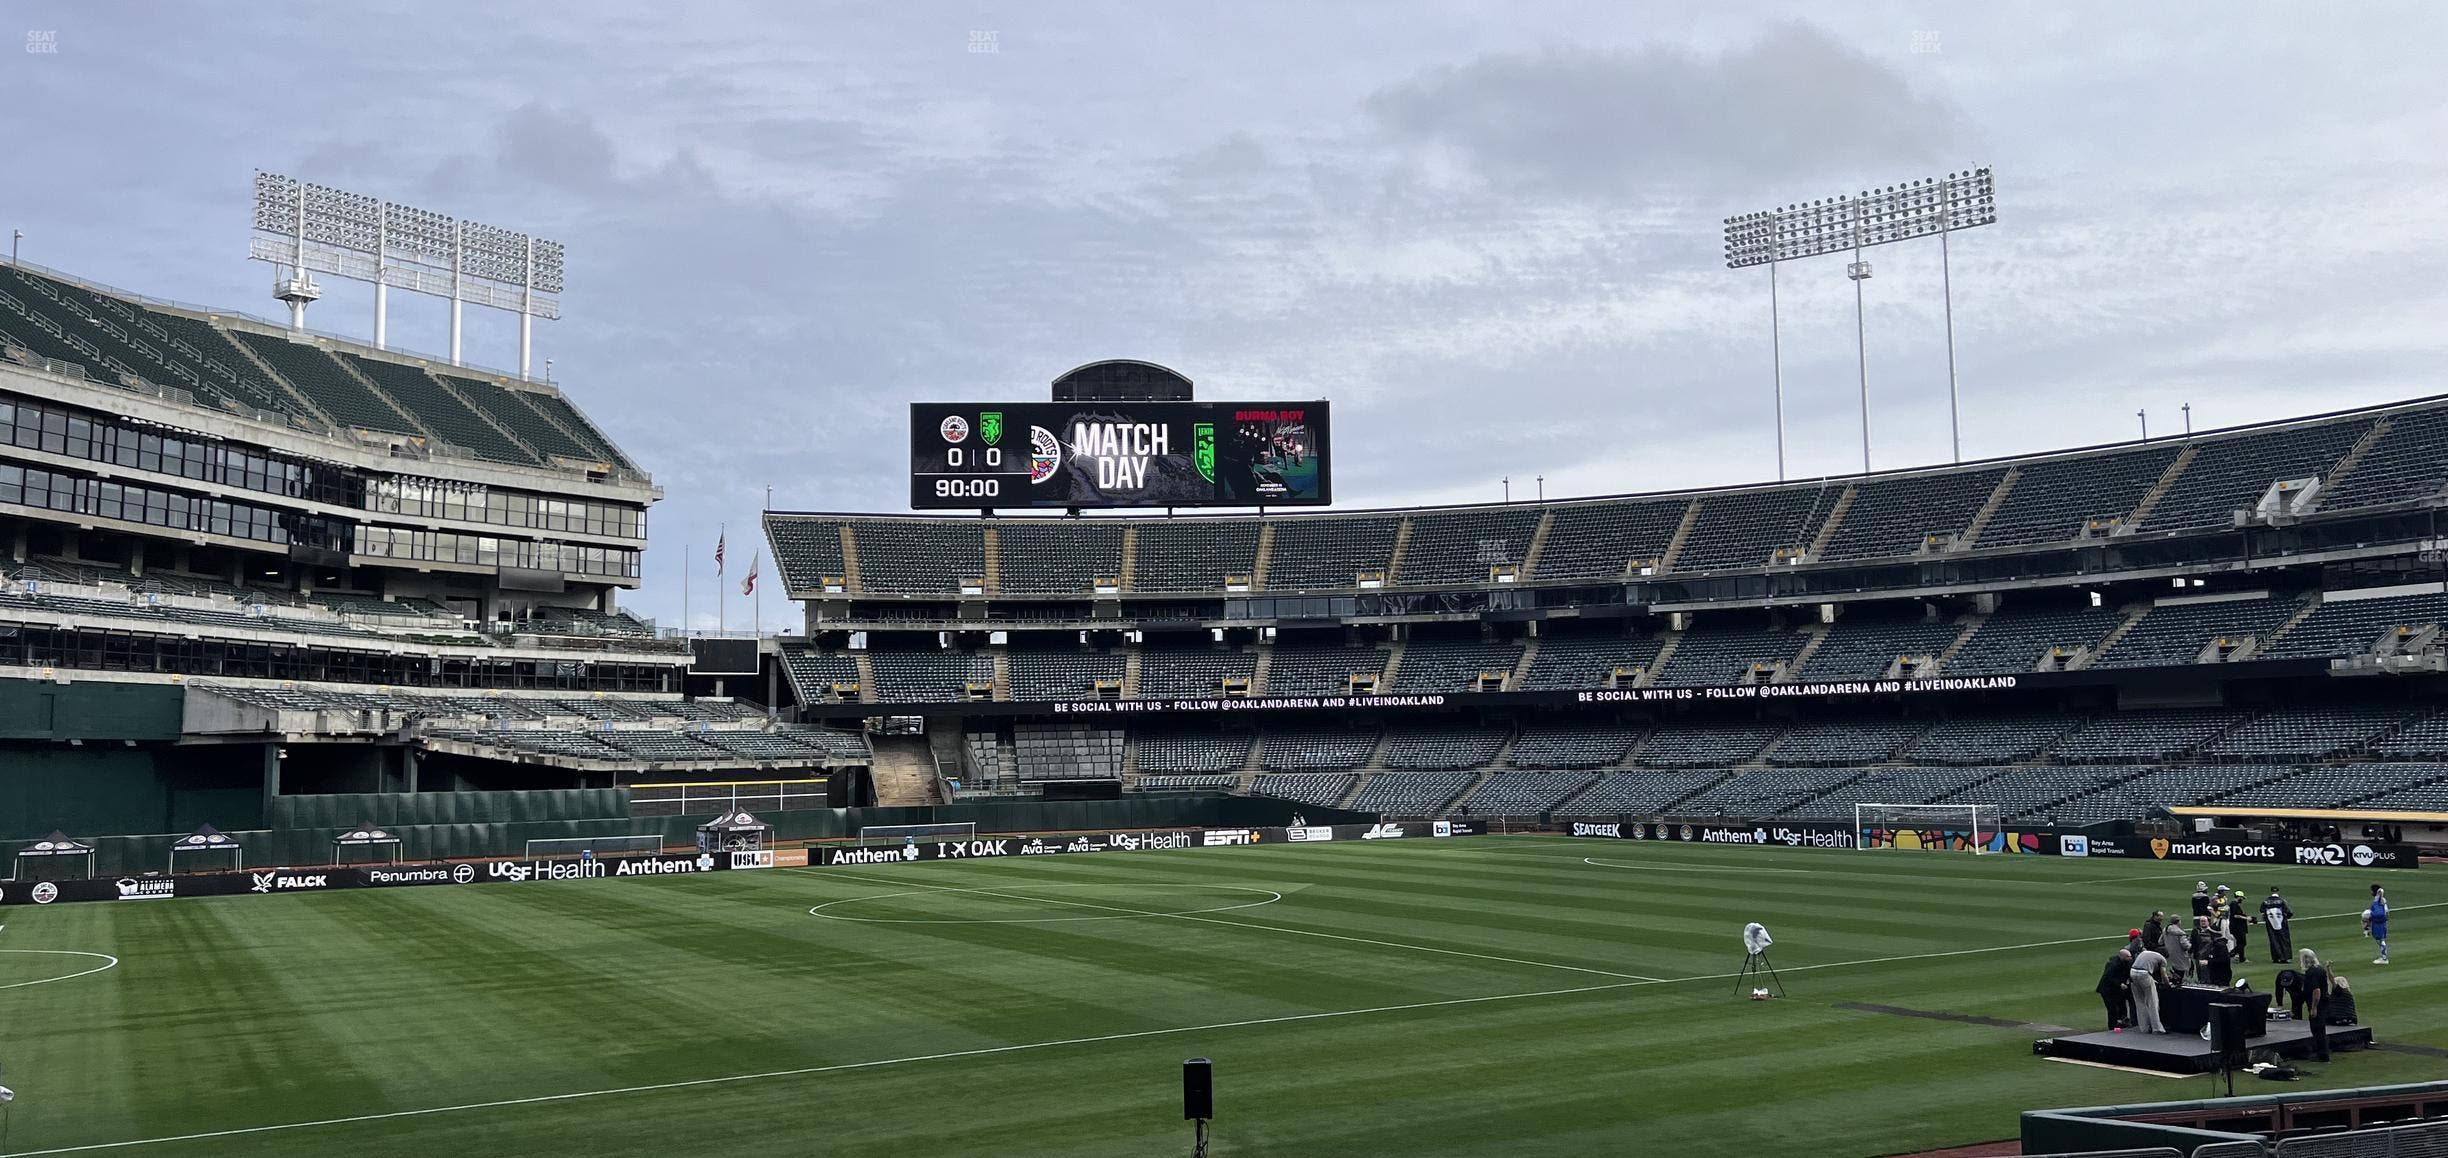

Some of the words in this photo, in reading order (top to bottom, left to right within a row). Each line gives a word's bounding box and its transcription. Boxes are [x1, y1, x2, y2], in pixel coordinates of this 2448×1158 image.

[1037, 431, 1058, 456] ROOTS
[1075, 422, 1168, 455] MATCH
[948, 448, 963, 466] 0
[986, 448, 1001, 466] 0
[1098, 456, 1149, 489] DAY
[935, 479, 999, 497] 90:00
[1578, 692, 1593, 702] BE
[1597, 691, 1639, 701] SOCIAL
[1642, 690, 1673, 700] WITH
[1677, 689, 1693, 699] US
[1706, 687, 1756, 698] FOLLOW
[1760, 683, 1870, 698] @OAKLANDARENA
[1874, 682, 1900, 692] AND
[1904, 676, 2016, 691] #LIVEINOAKLAND
[1054, 703, 1068, 712] BE
[1072, 702, 1112, 712] SOCIAL
[1115, 702, 1143, 711] WITH
[1147, 701, 1162, 711] US
[1174, 701, 1218, 711] FOLLOW
[1221, 698, 1319, 711] @OAKLANDARENA
[1323, 698, 1345, 707] AND
[1349, 695, 1444, 707] #LIVEINOAKLAND
[1573, 822, 1621, 838] SEATGEEK
[1703, 828, 1752, 843] Anthem
[1773, 828, 1802, 846] UCSF
[1803, 829, 1853, 848] Health
[937, 842, 947, 858] I
[971, 840, 1008, 857] OAK
[1067, 842, 1088, 853] Ava
[1110, 834, 1139, 850] UCSF
[1142, 832, 1191, 850] Health
[832, 848, 901, 865] Anthem
[1021, 845, 1043, 855] Ava
[2172, 842, 2220, 855] marka
[2224, 844, 2275, 859] sports
[2295, 846, 2325, 860] FOX
[616, 858, 695, 876] Anthem
[733, 853, 759, 866] USL
[370, 868, 448, 883] Penumbra
[489, 861, 532, 882] UCSF
[535, 858, 605, 880] Health
[140, 883, 174, 891] ALAMEDA
[277, 875, 327, 888] FALCK
